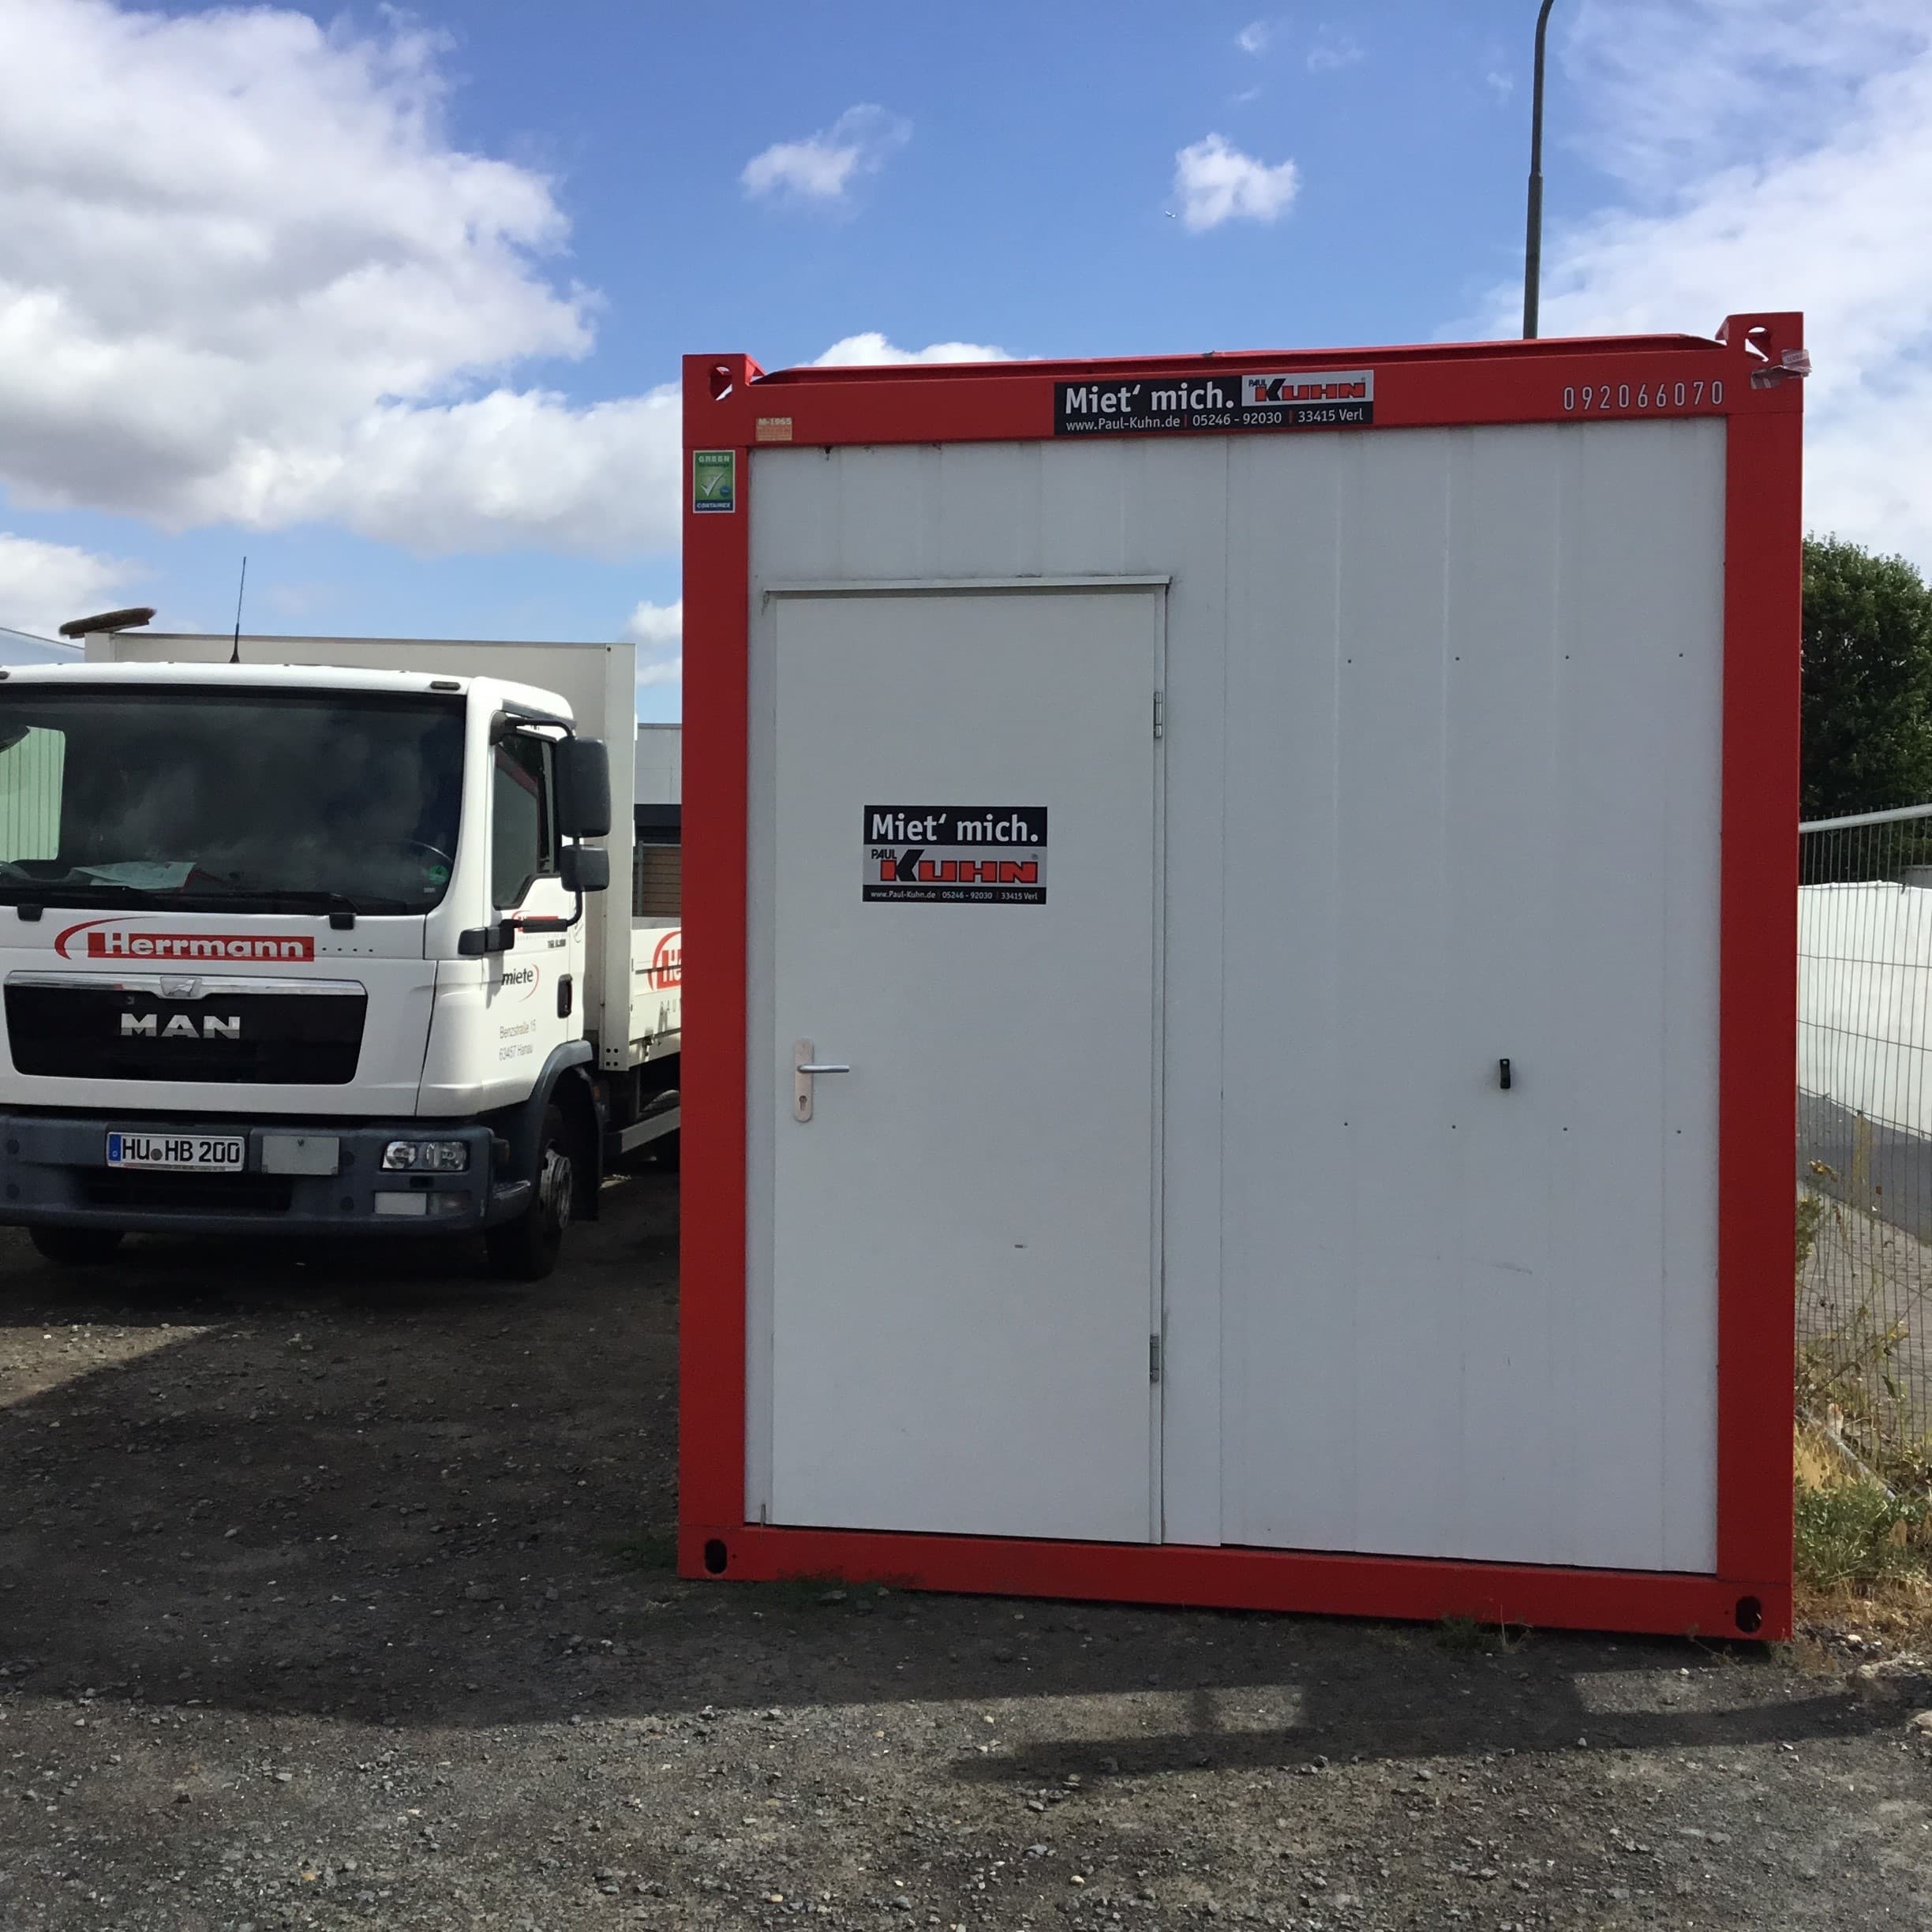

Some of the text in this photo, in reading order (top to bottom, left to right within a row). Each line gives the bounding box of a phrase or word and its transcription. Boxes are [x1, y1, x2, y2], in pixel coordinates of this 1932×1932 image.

[1151, 380, 1234, 411] mich.
[1249, 379, 1267, 388] PAUL
[1254, 378, 1366, 402] KUHN
[1563, 380, 1723, 410] 092066070
[1065, 414, 1181, 431] www.Paul-Kuhn.de
[1193, 414, 1231, 427] 05246
[1243, 411, 1282, 425] 92030
[1297, 410, 1335, 422] 33415
[1339, 408, 1364, 421] Verl
[957, 814, 1039, 842] mich.
[871, 848, 897, 859] PAUL
[881, 849, 1039, 884] KUHN
[870, 890, 936, 899] www.Paul-Kuhn.de
[942, 891, 964, 900] 05246
[1001, 892, 1023, 900] 33415
[104, 932, 304, 959] Herrmann
[501, 968, 534, 986] miete
[121, 1013, 241, 1039] MAN
[122, 1138, 241, 1163] HU HB 200
